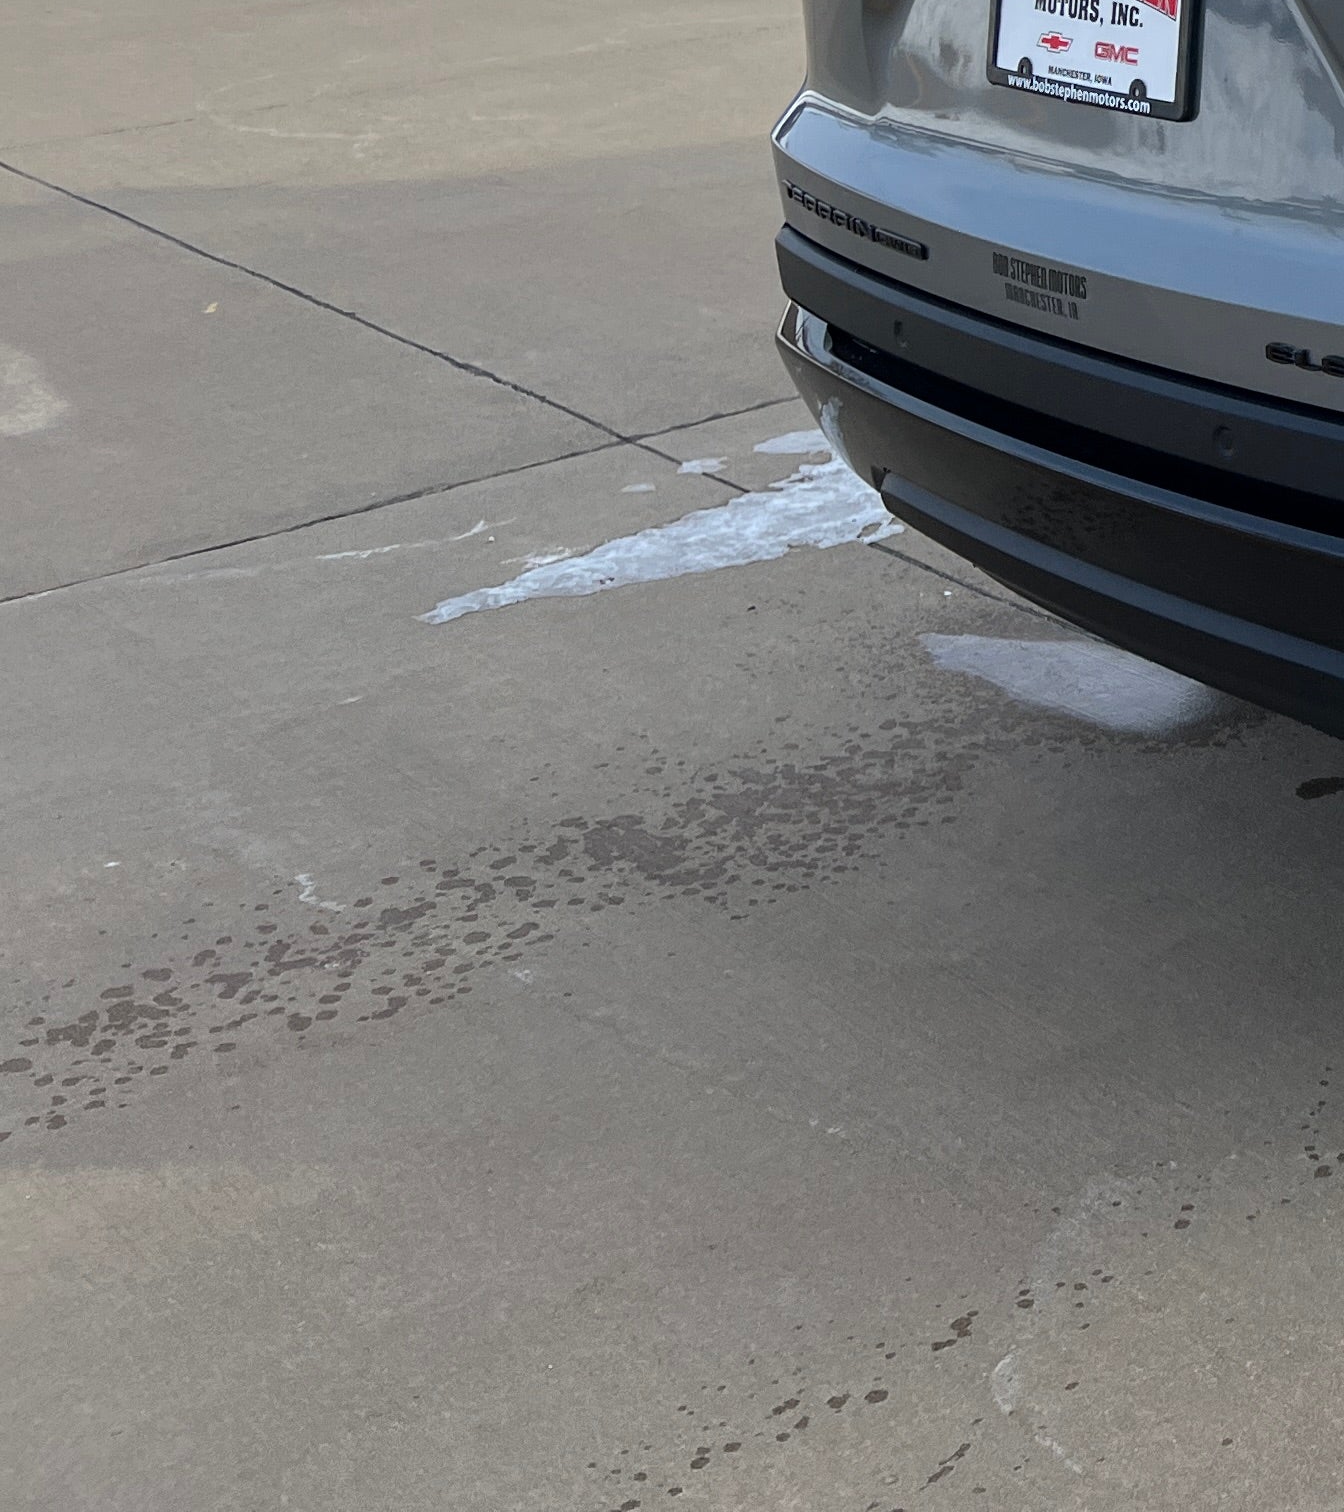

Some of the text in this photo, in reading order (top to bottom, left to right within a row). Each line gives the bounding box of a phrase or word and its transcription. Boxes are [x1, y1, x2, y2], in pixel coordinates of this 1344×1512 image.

[1110, 1, 1144, 28] INC.
[1094, 40, 1140, 66] GMC
[1094, 72, 1112, 86] IOWA
[1007, 74, 1151, 114] www.bobstephenmotors.com
[1010, 257, 1048, 290] STEPHEN
[1048, 269, 1087, 299] MOTORS
